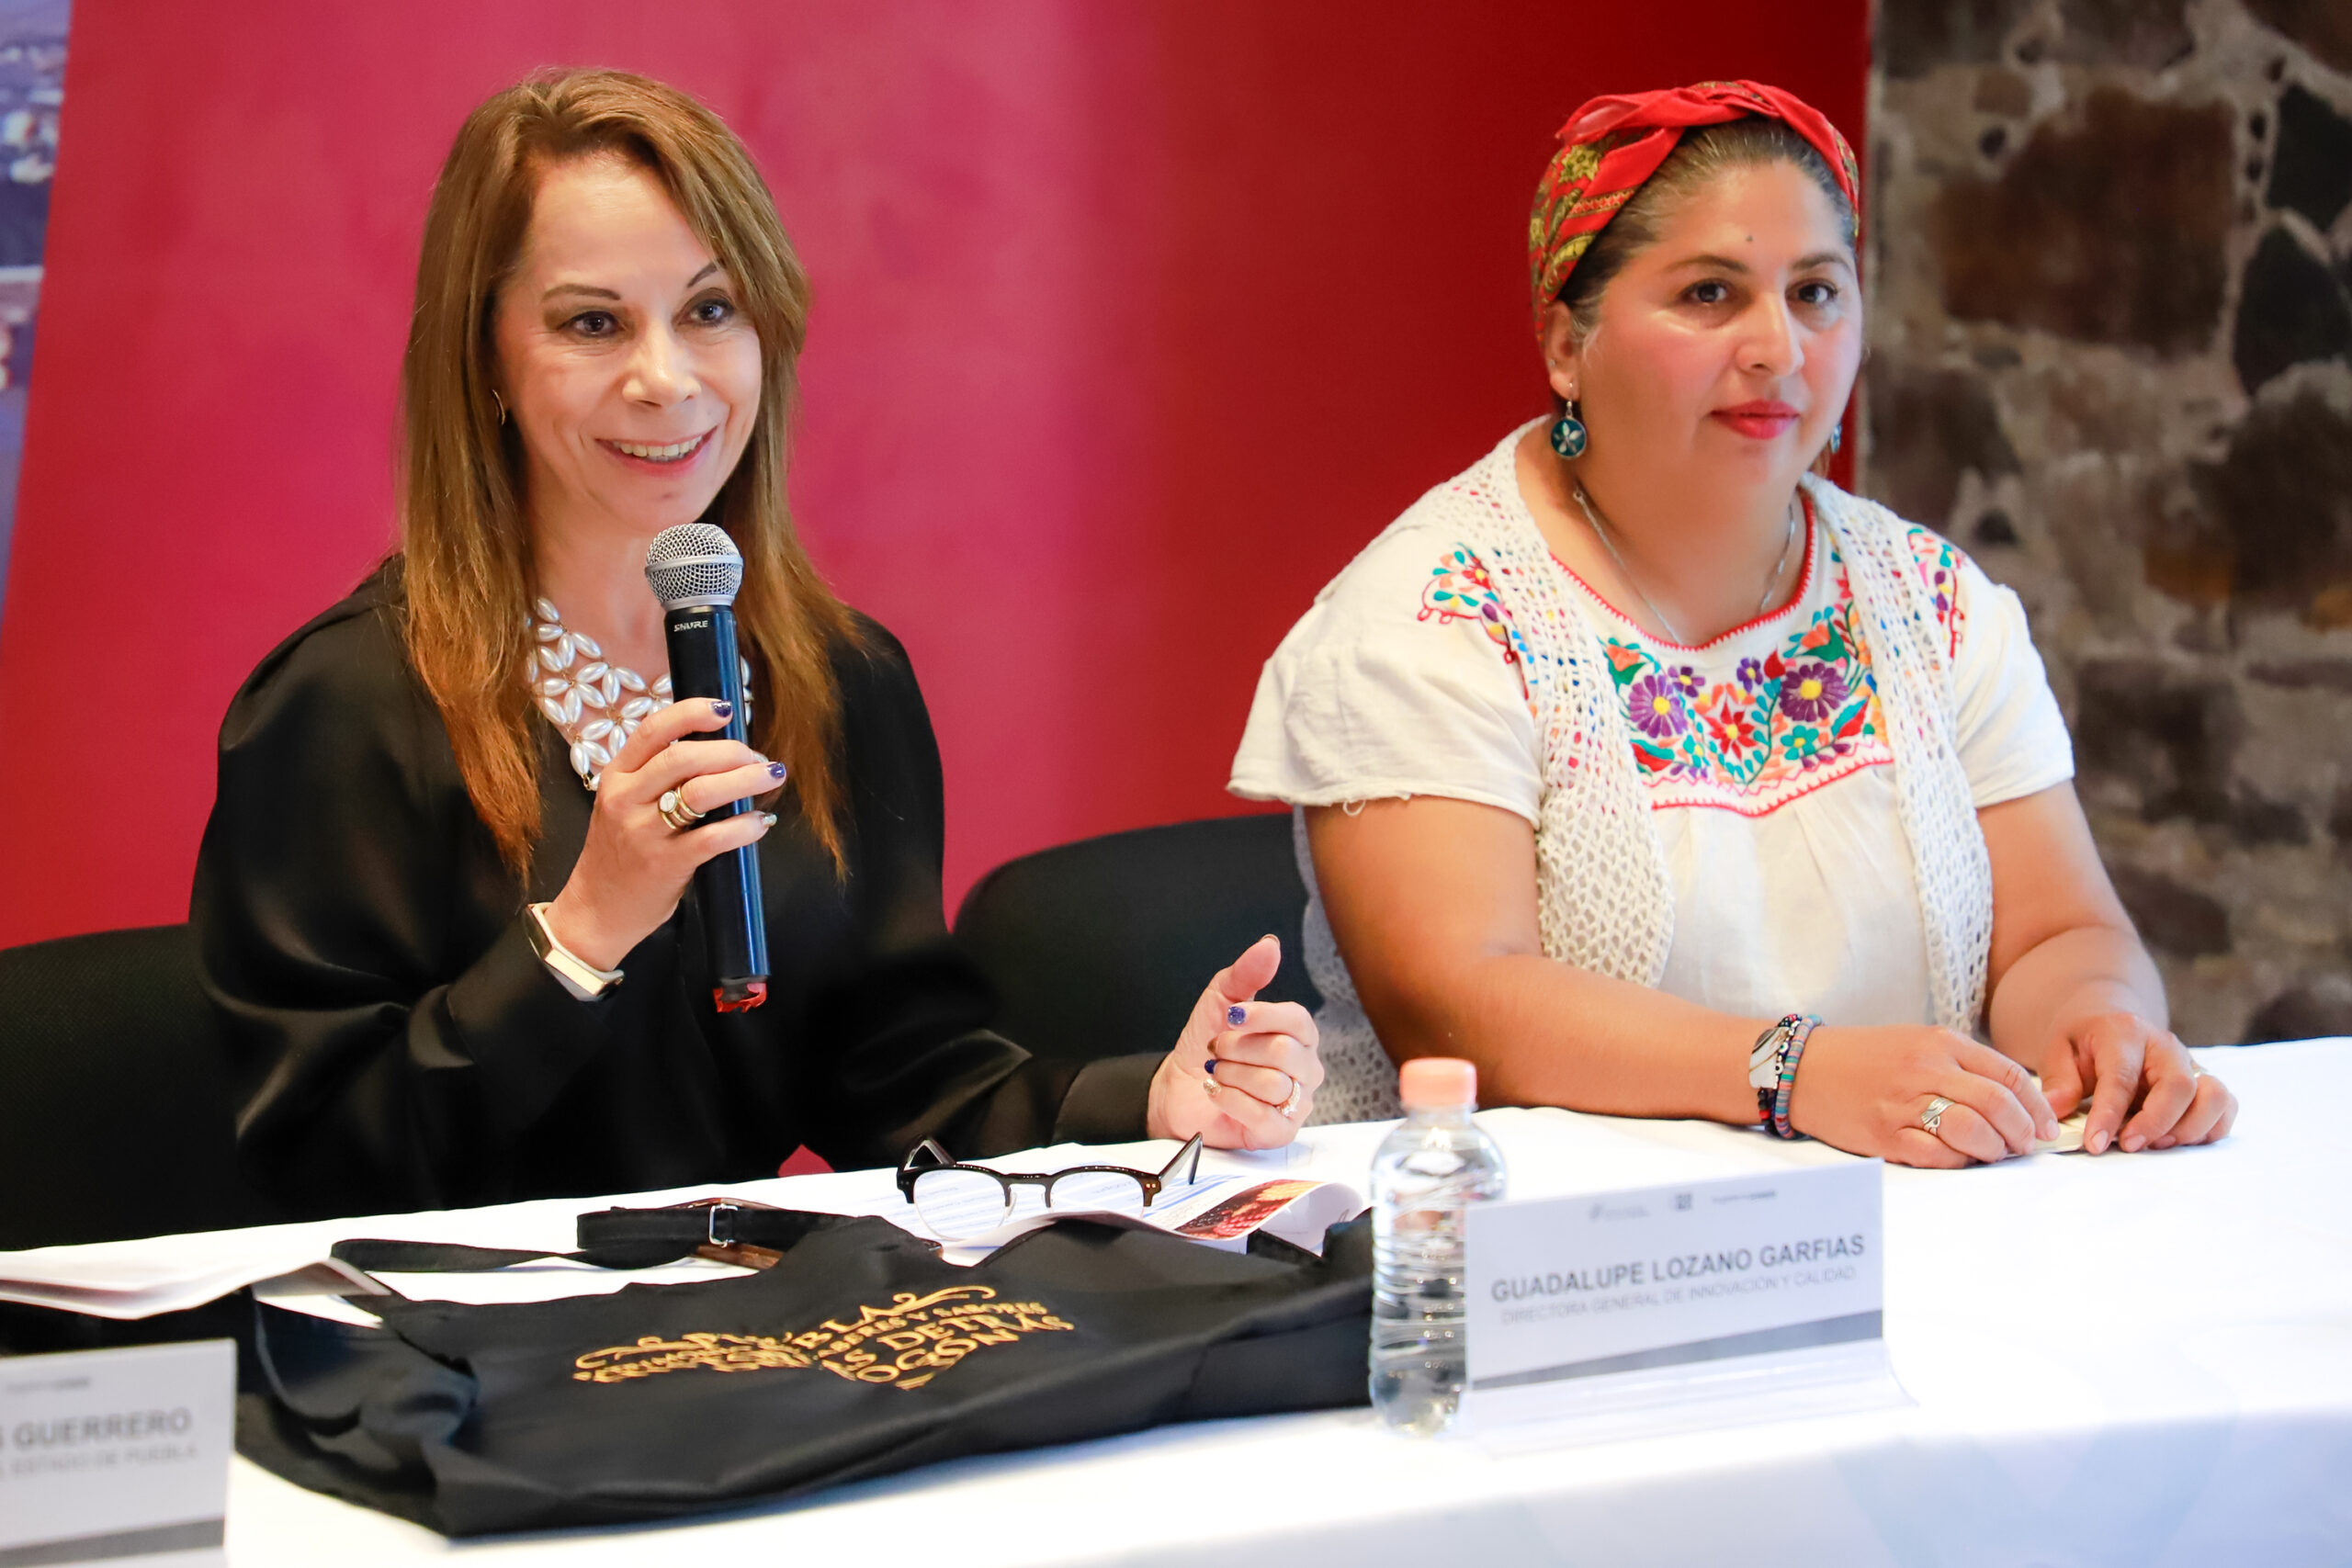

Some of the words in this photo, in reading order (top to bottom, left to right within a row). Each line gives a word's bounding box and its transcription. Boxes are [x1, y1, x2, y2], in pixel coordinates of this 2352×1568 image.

[673, 620, 708, 632] SHURE
[1491, 1261, 1645, 1303] GUADALUPE
[1652, 1248, 1752, 1283] LOZANO
[1759, 1234, 1865, 1268] GARFIAS
[1501, 1302, 1589, 1325] DIRECTORA
[1592, 1292, 1661, 1315] GENERAL
[1664, 1286, 1683, 1304] DE
[1780, 1273, 1791, 1287] Y
[1792, 1265, 1857, 1288] CALIDAD
[12, 1406, 192, 1450] GUERRERO
